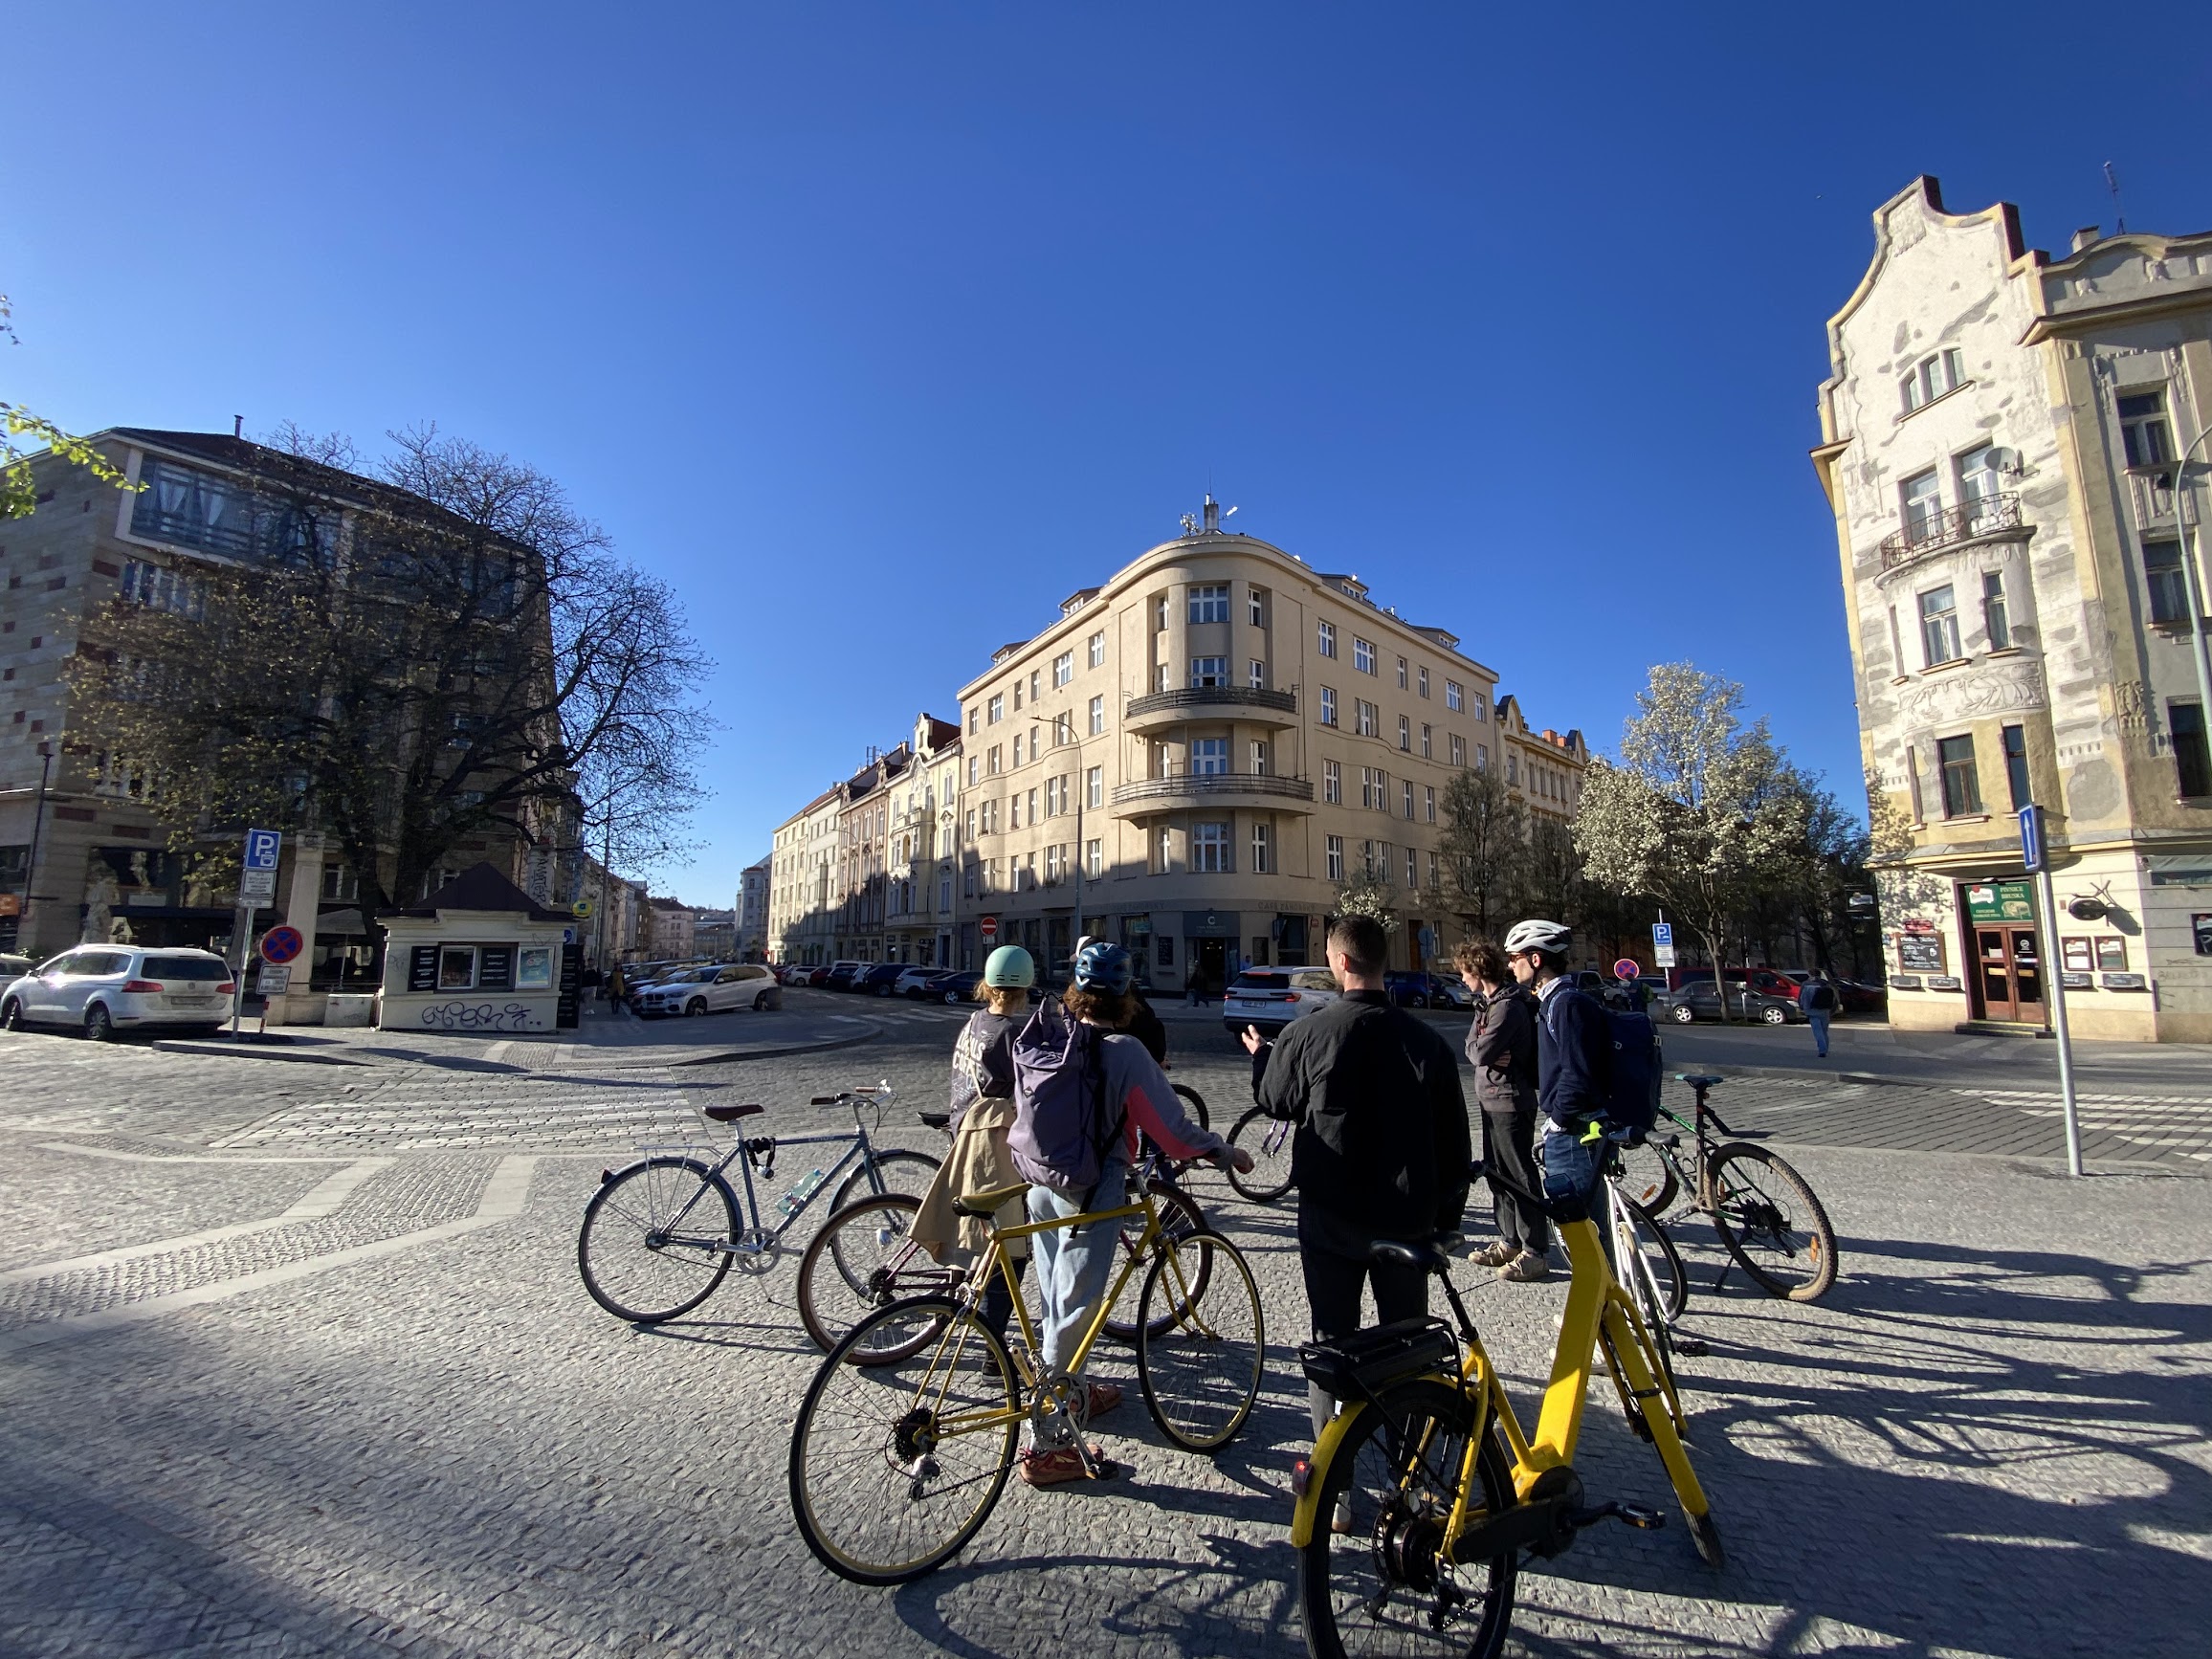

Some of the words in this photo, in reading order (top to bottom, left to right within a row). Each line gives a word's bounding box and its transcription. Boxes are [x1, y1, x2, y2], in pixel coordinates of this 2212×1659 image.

[255, 834, 275, 856] P
[1656, 926, 1667, 939] P
[953, 1051, 984, 1082] COFFE
